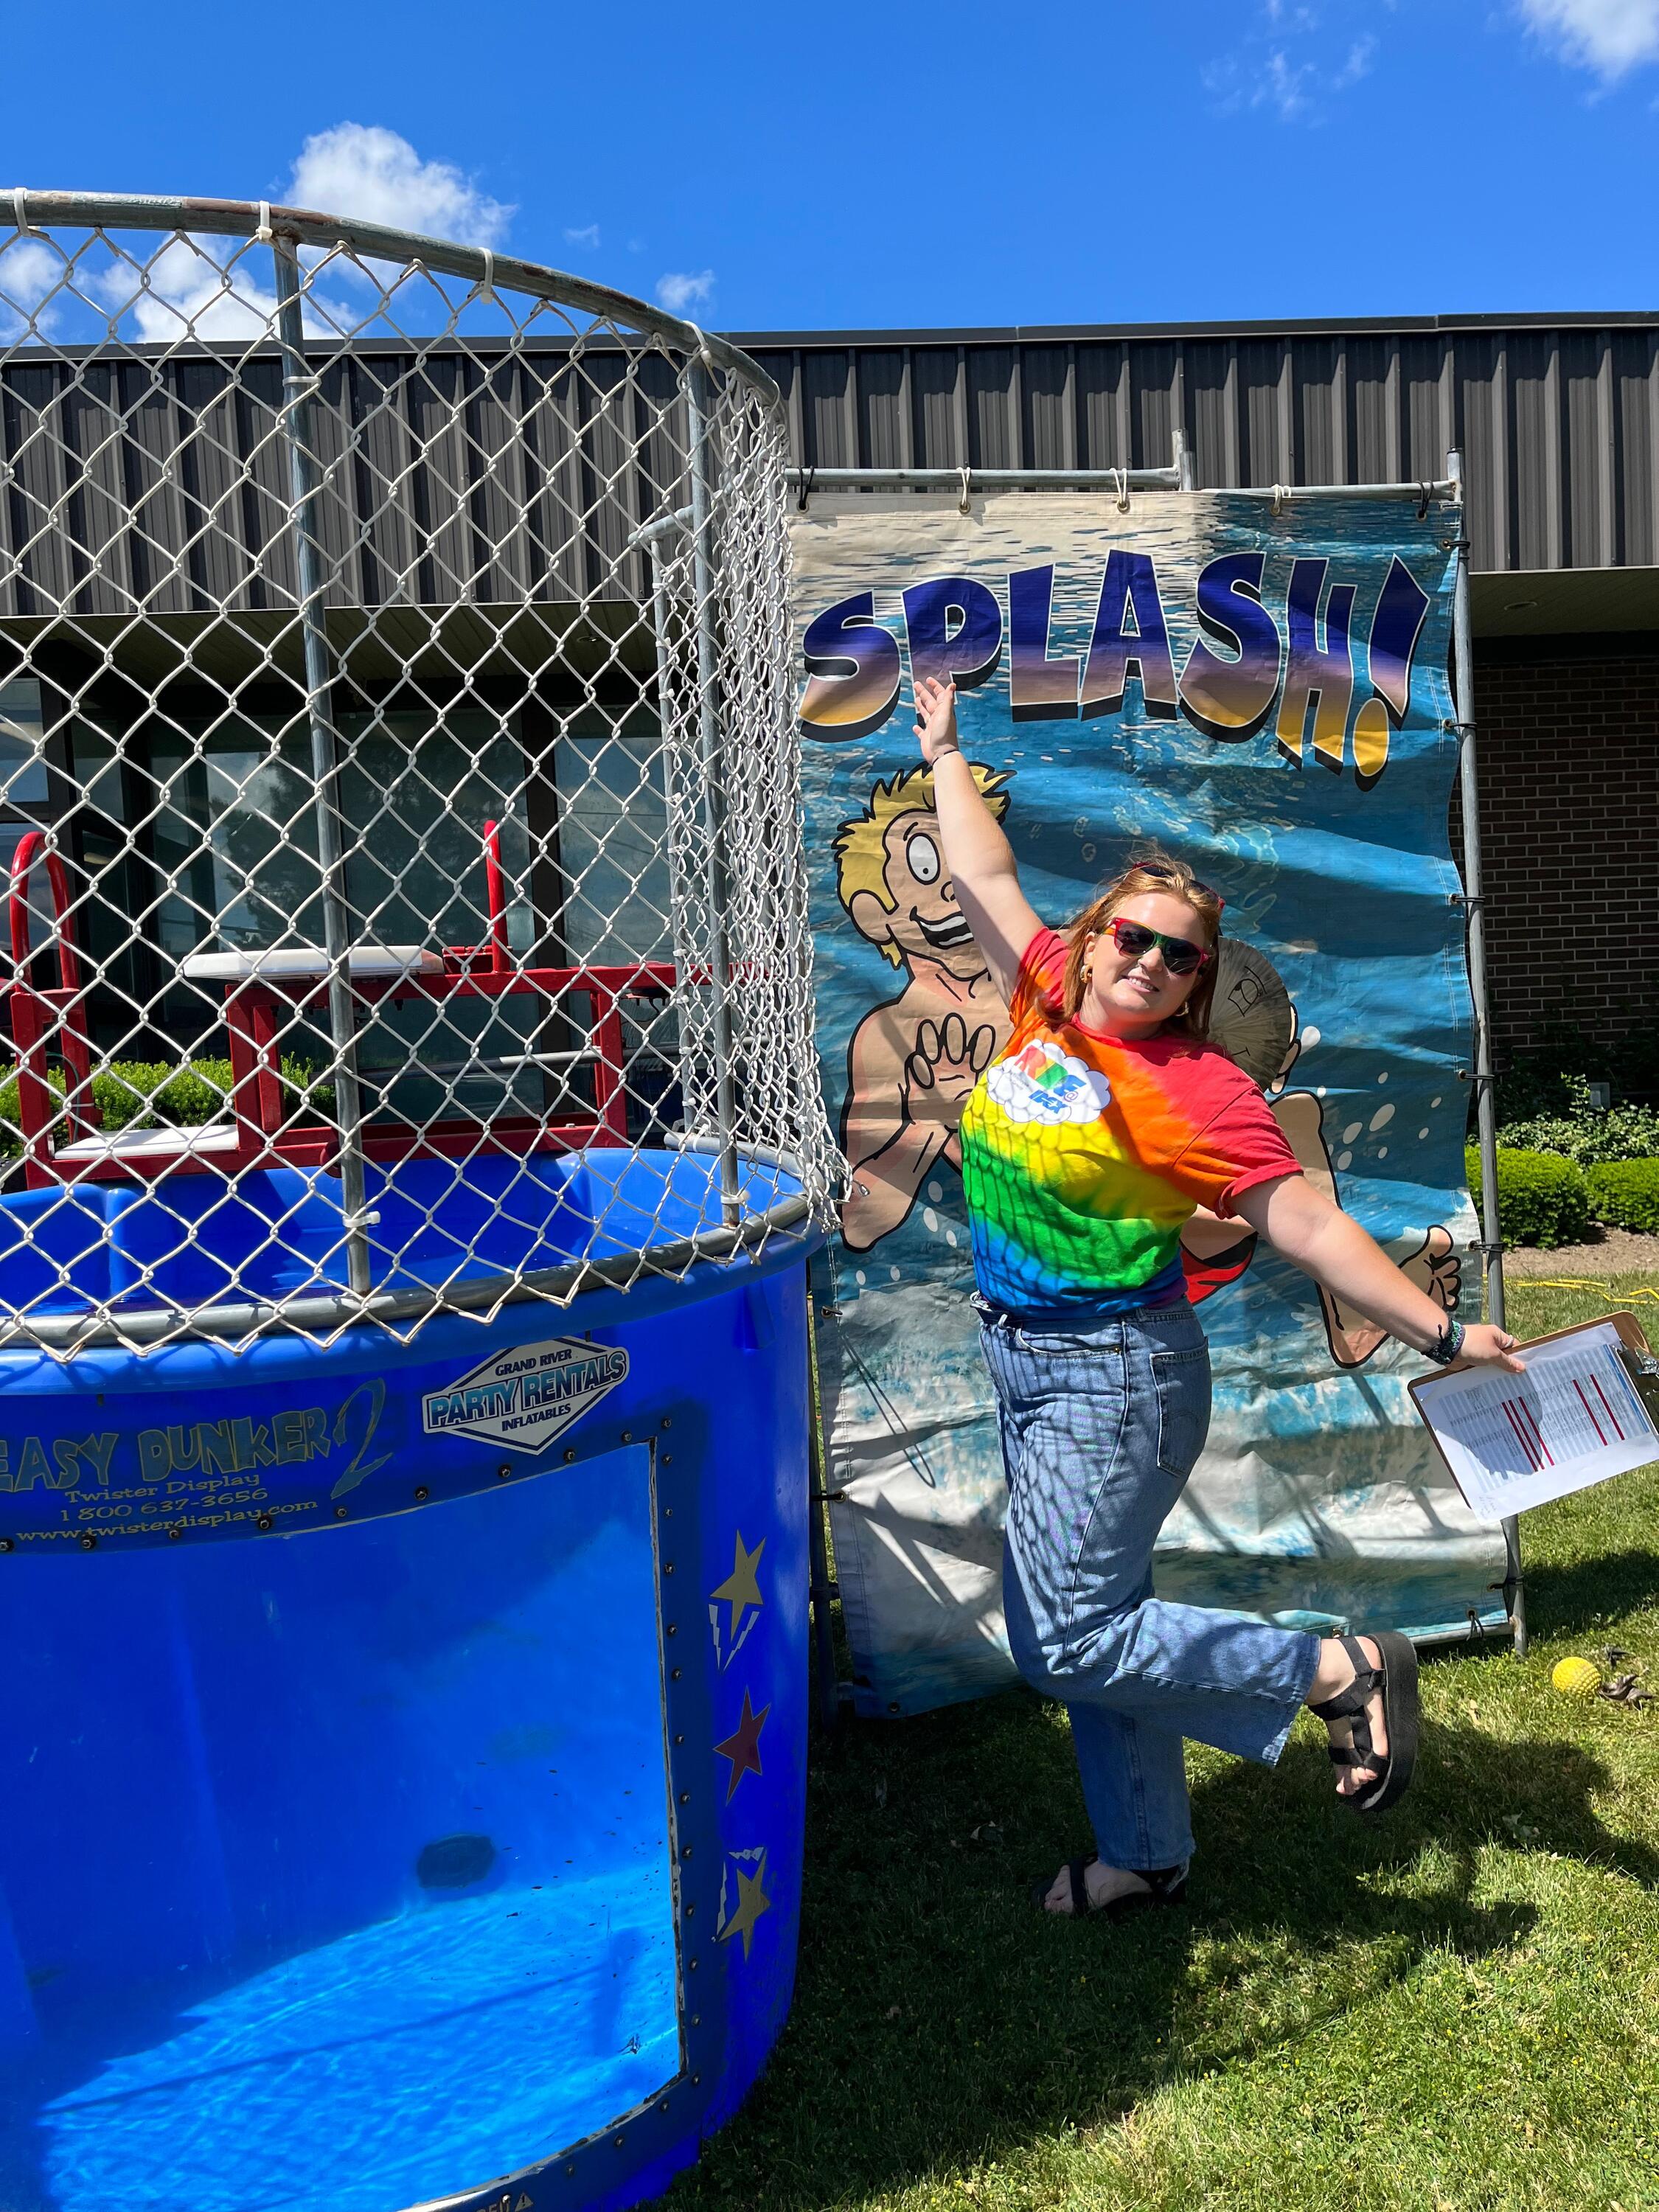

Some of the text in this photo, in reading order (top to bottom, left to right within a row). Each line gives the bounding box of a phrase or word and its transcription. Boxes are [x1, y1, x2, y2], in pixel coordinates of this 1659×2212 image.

[799, 549, 1430, 791] SPLASH!
[495, 1349, 572, 1377] GRAND RIVER
[428, 1352, 626, 1427] PARTY RENTALS
[501, 1403, 571, 1431] INFLATABLES
[138, 1408, 331, 1481] DUNKER
[330, 1377, 394, 1500] 2
[60, 1488, 268, 1522] 1 800 637-3656
[65, 1475, 260, 1503] Twister Display
[16, 1500, 319, 1541] www.twisterdisplay.com
